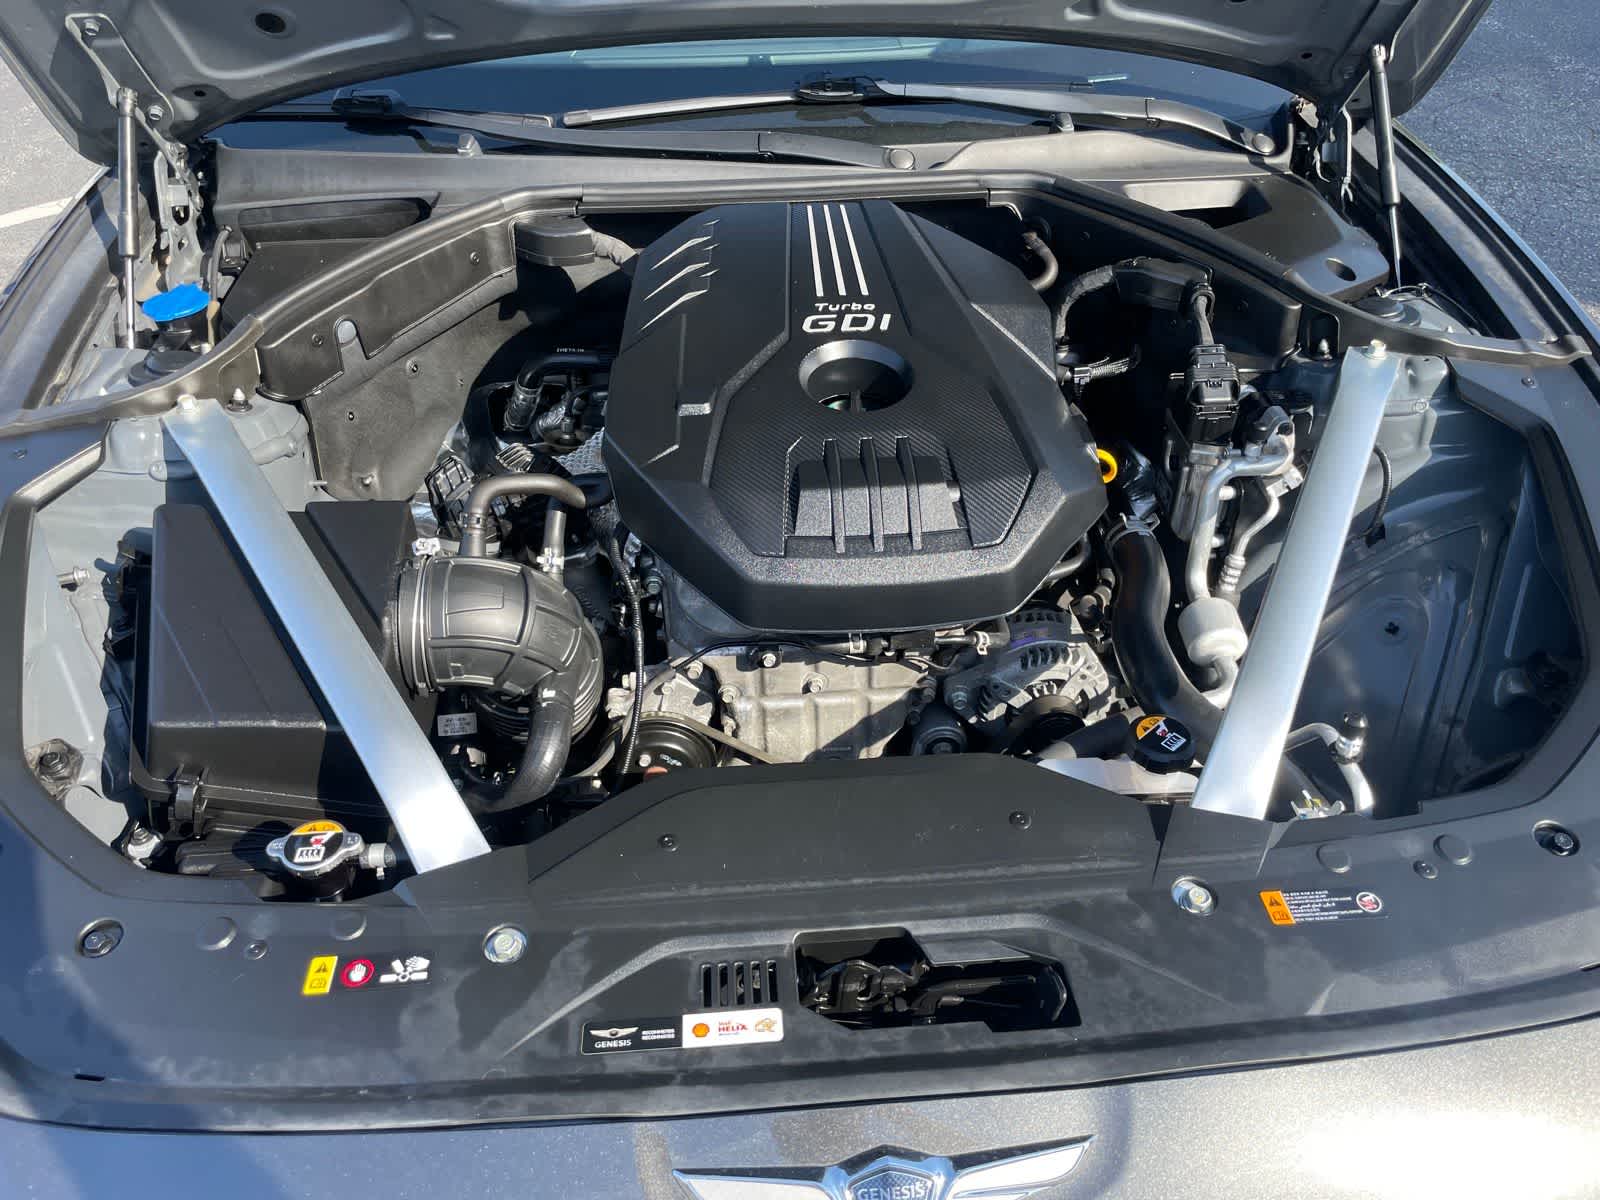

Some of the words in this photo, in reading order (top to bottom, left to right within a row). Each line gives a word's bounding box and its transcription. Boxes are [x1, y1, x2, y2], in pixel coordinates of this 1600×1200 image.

[814, 302, 876, 311] Turbo
[802, 313, 892, 333] GDI
[718, 1023, 749, 1033] HELIX
[594, 1039, 632, 1049] GENESIS
[858, 1182, 925, 1200] GENESIS
